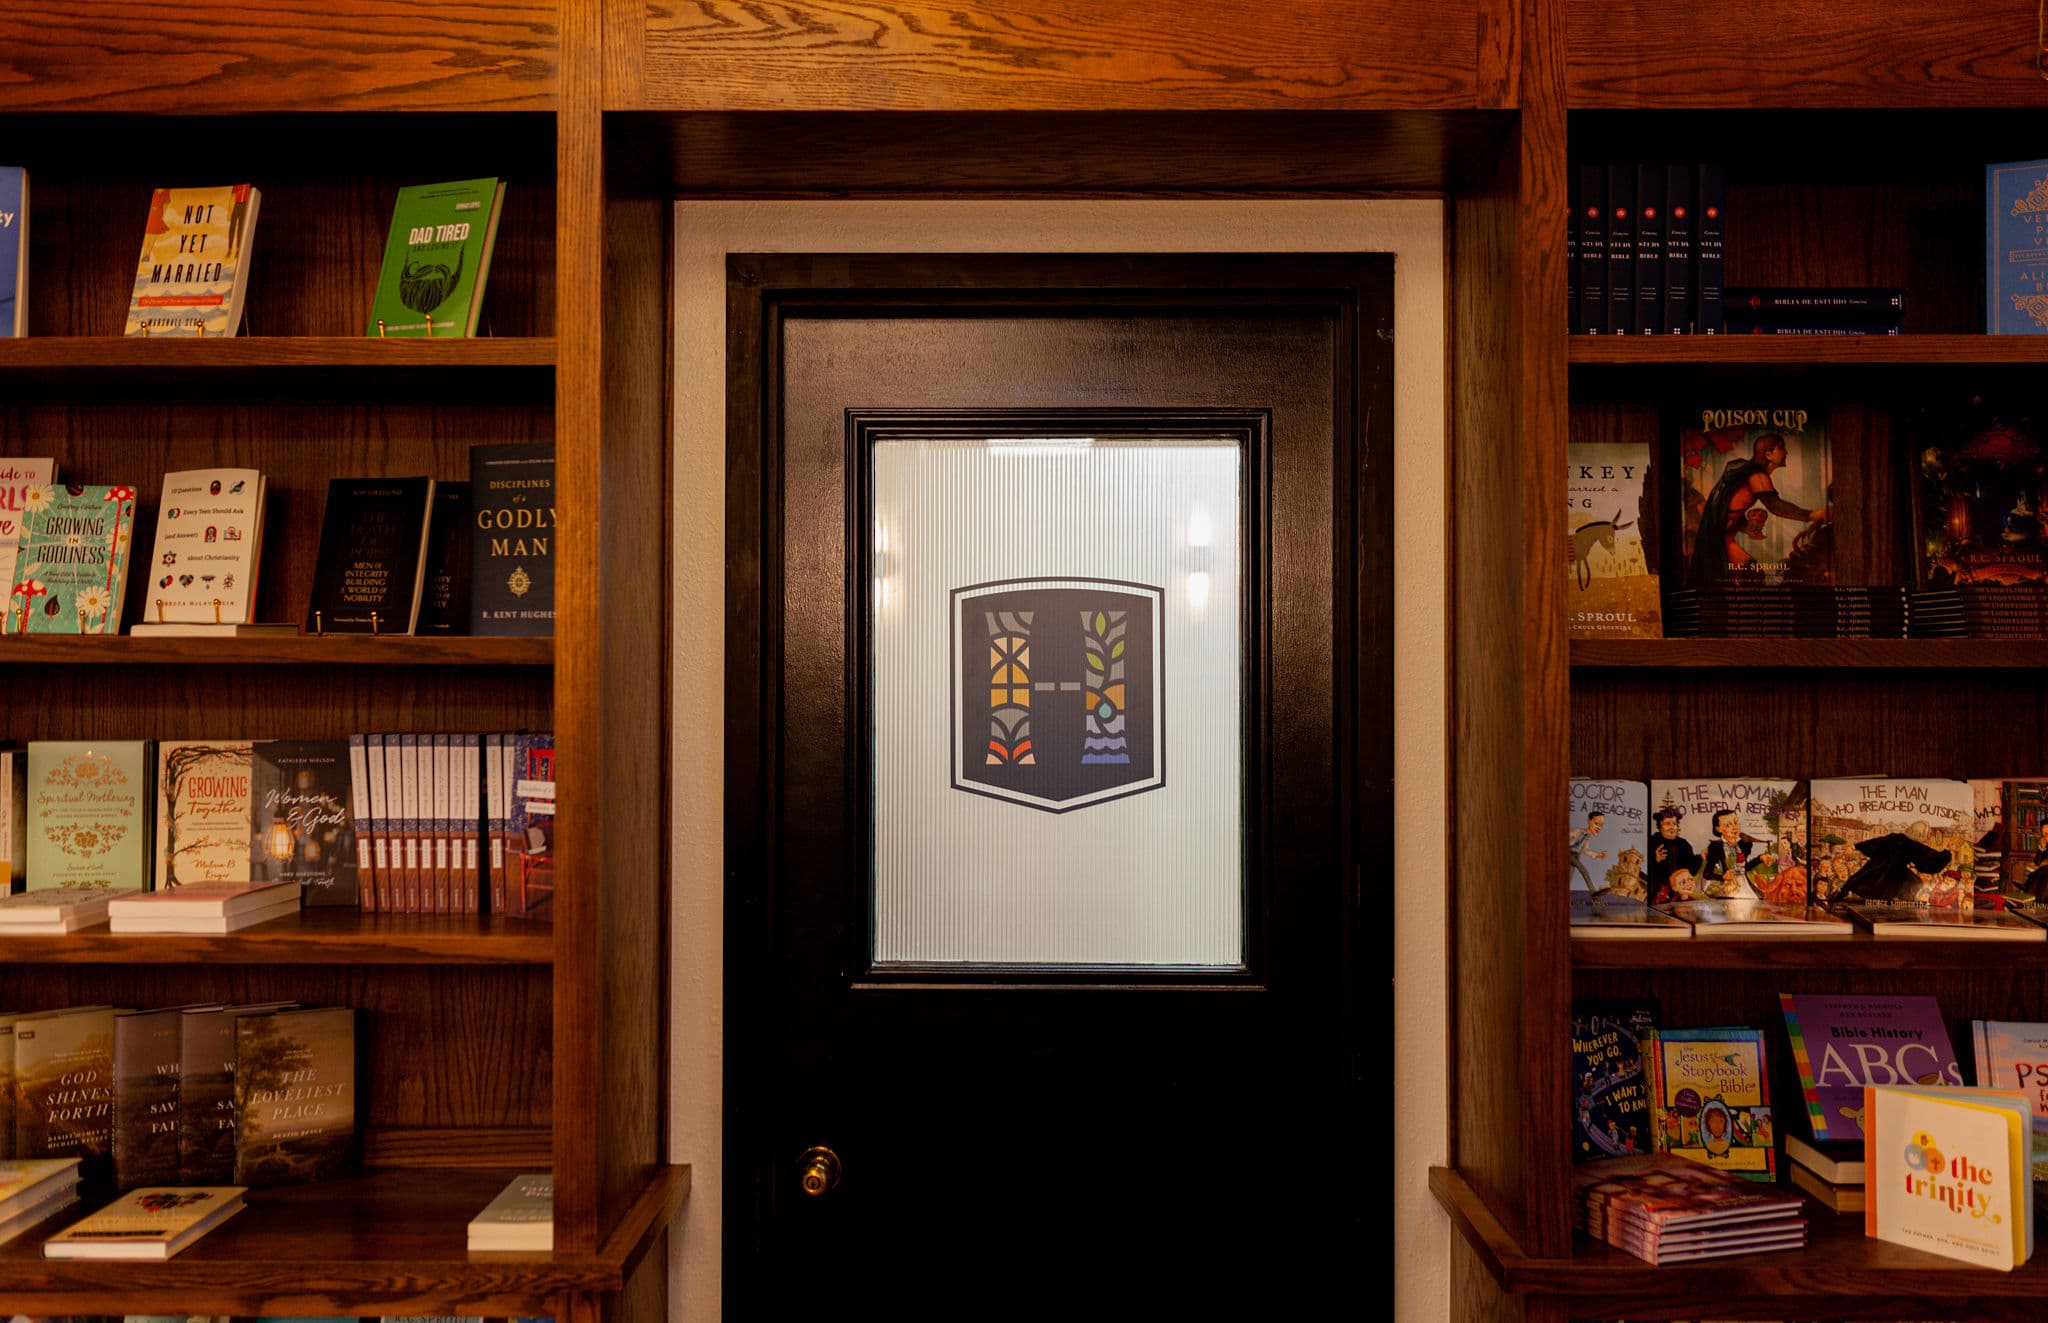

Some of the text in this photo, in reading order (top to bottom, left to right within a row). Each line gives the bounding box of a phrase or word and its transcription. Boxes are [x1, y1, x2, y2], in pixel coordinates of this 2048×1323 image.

[184, 204, 215, 224] NOT
[179, 233, 208, 253] YET
[408, 223, 470, 246] DAD TIRED
[150, 263, 222, 283] MARRIED
[1702, 409, 1808, 432] POISON CUP
[25, 470, 35, 480] TO
[1568, 466, 1635, 479] KEY
[489, 480, 551, 489] DISCIPLINES
[512, 494, 522, 503] of
[183, 509, 198, 517] Every
[46, 517, 104, 536] GROWING
[68, 537, 80, 545] IN
[490, 538, 549, 557] MAN
[37, 545, 106, 565] GODLINESS
[204, 554, 240, 562] Christianity
[1995, 554, 2042, 563] SPROUL
[345, 578, 386, 586] BUILDING
[348, 586, 378, 594] WORLD
[344, 594, 384, 602] NOBILITY
[493, 611, 518, 619] KENT
[1577, 612, 1637, 622] SPROUL
[188, 776, 249, 798] GROWING
[1678, 783, 1785, 801] THE WOMAN
[1859, 785, 1929, 801] THE MAN
[264, 787, 338, 809] Women
[187, 800, 245, 819] Together
[1580, 801, 1588, 812] A
[1592, 801, 1643, 821] PREACHER
[1691, 802, 1729, 814] HELPED
[1734, 801, 1742, 813] A
[1828, 800, 1962, 821] WHO PREACHED OUTSIDE
[1973, 805, 2001, 820] WHO
[301, 806, 346, 835] God
[1832, 1026, 1924, 1041] Bible History
[1572, 1032, 1619, 1054] WHEREVER
[1587, 1053, 1604, 1067] YOU
[1675, 1049, 1709, 1066] Jesus
[1815, 1042, 1964, 1088] ABCs
[60, 1070, 98, 1086] GOD
[281, 1070, 318, 1084] THE
[1682, 1063, 1748, 1082] Storybook
[251, 1084, 345, 1105] LOVELIEST
[1605, 1085, 1638, 1106] I WANT
[1720, 1079, 1753, 1094] Bible
[46, 1086, 111, 1107] SHINES
[48, 1103, 109, 1124] FORTH
[272, 1103, 325, 1121] PLACE
[1618, 1101, 1631, 1115] TO
[1951, 1156, 1993, 1185] the
